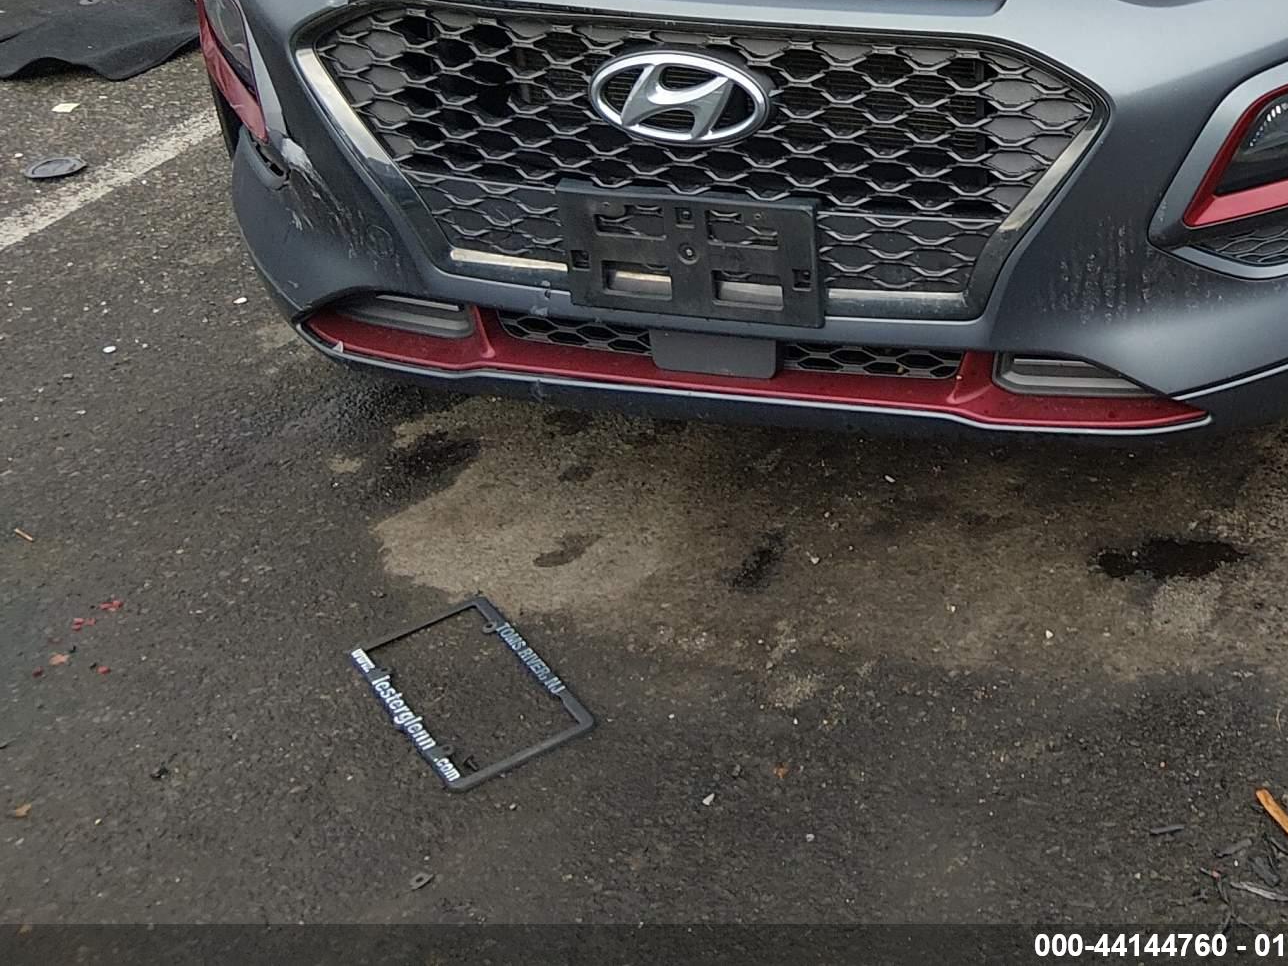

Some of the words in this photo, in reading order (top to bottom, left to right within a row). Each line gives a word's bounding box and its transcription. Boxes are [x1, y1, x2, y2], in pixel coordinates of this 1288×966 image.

[496, 621, 527, 653] TOMS
[517, 647, 550, 681] RIVER,
[543, 675, 567, 695] NJ
